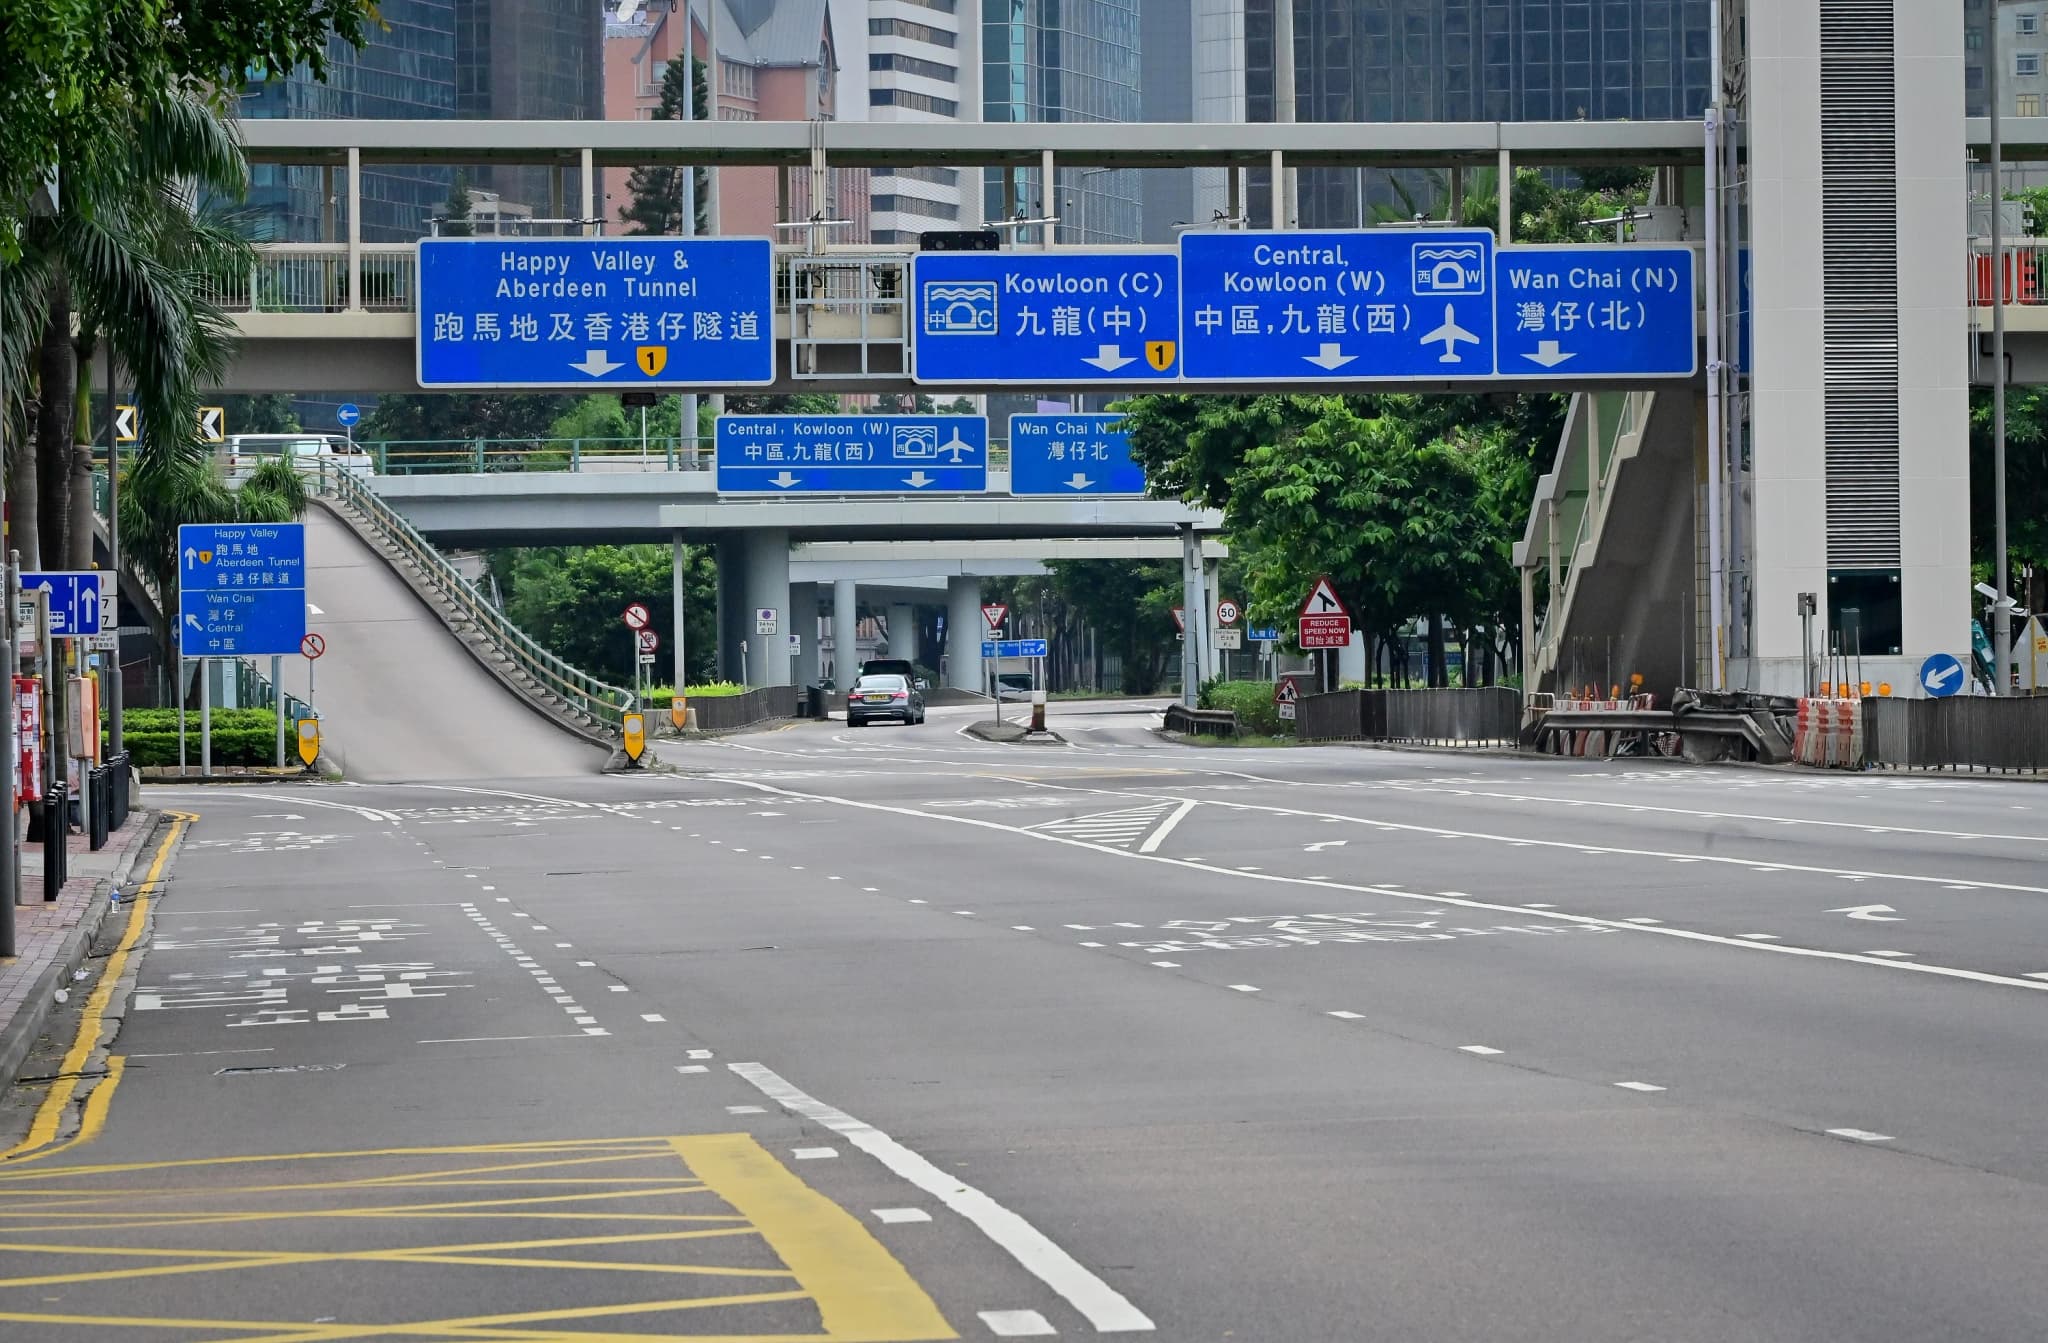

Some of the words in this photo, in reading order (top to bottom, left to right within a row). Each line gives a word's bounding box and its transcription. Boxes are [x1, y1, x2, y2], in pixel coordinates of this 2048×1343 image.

[501, 250, 570, 275] Happy
[591, 250, 656, 274] Valley
[673, 250, 688, 270] &
[1254, 244, 1349, 267] Central,
[1224, 271, 1326, 292] Kowloon
[1337, 270, 1385, 296] (W)
[1417, 271, 1431, 283] 西
[1466, 270, 1480, 283] W
[1509, 268, 1559, 289] Wan
[1569, 267, 1621, 289] Chai
[1632, 267, 1678, 293] (N)
[496, 278, 606, 298] Aberdeen
[623, 277, 697, 297] Tunnel
[1005, 272, 1108, 294] Kowloon
[1118, 272, 1163, 297] (C)
[929, 310, 946, 329] 中
[977, 310, 993, 328] C
[1016, 306, 1147, 337] 九龍(中)
[1516, 301, 1645, 332] 灣仔(北)
[433, 311, 760, 342] 跑馬地及香港仔隧道
[646, 352, 655, 370] 1
[1155, 345, 1164, 365] 1
[794, 422, 853, 434] Kowloon
[863, 422, 890, 435] (W)
[1018, 422, 1048, 435] Wan
[1056, 422, 1087, 434] Chai
[1048, 441, 1109, 461] 灣仔北
[214, 529, 245, 540] Happy
[250, 529, 278, 540] Valley
[216, 543, 259, 556] 跑馬地
[215, 558, 264, 567] Aberdeen
[268, 556, 300, 567] Tunnel
[217, 572, 290, 585] 香港仔隧道
[207, 594, 229, 603] Wan
[208, 609, 235, 622] 灣仔
[1221, 608, 1235, 618] 50
[207, 624, 243, 633] Central
[1328, 627, 1346, 635] NOW
[209, 638, 235, 651] 中區
